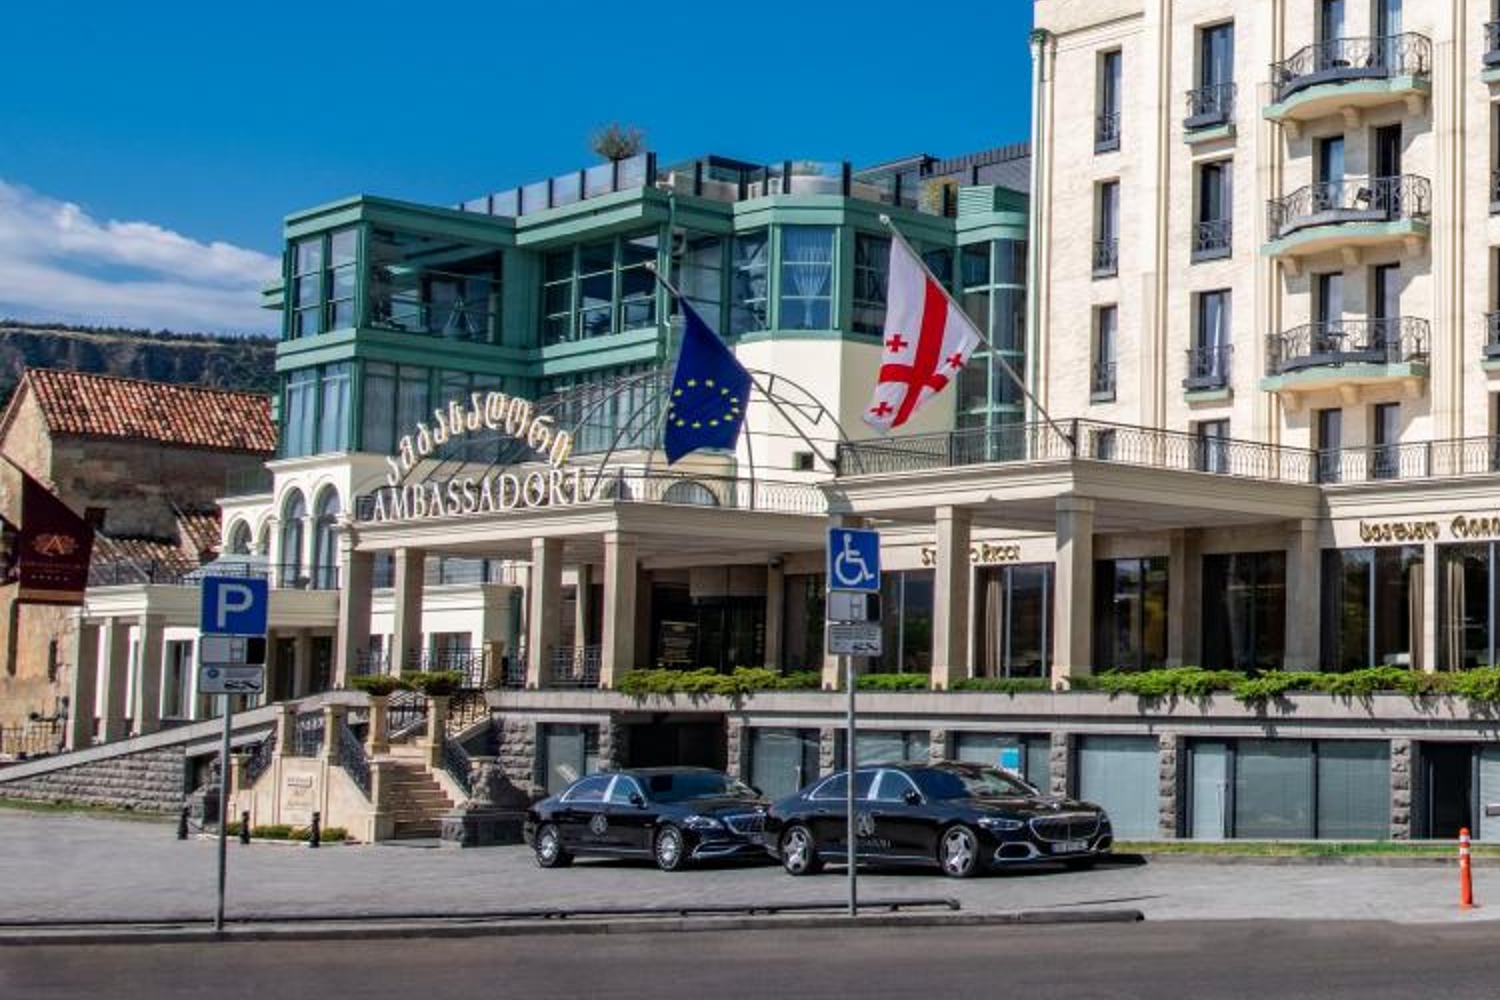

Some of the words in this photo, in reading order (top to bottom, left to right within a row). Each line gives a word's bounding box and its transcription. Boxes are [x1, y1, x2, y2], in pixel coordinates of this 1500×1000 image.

[385, 391, 573, 486] ამბასადორი
[373, 468, 588, 522] AMBASSADORI
[217, 583, 254, 628] P
